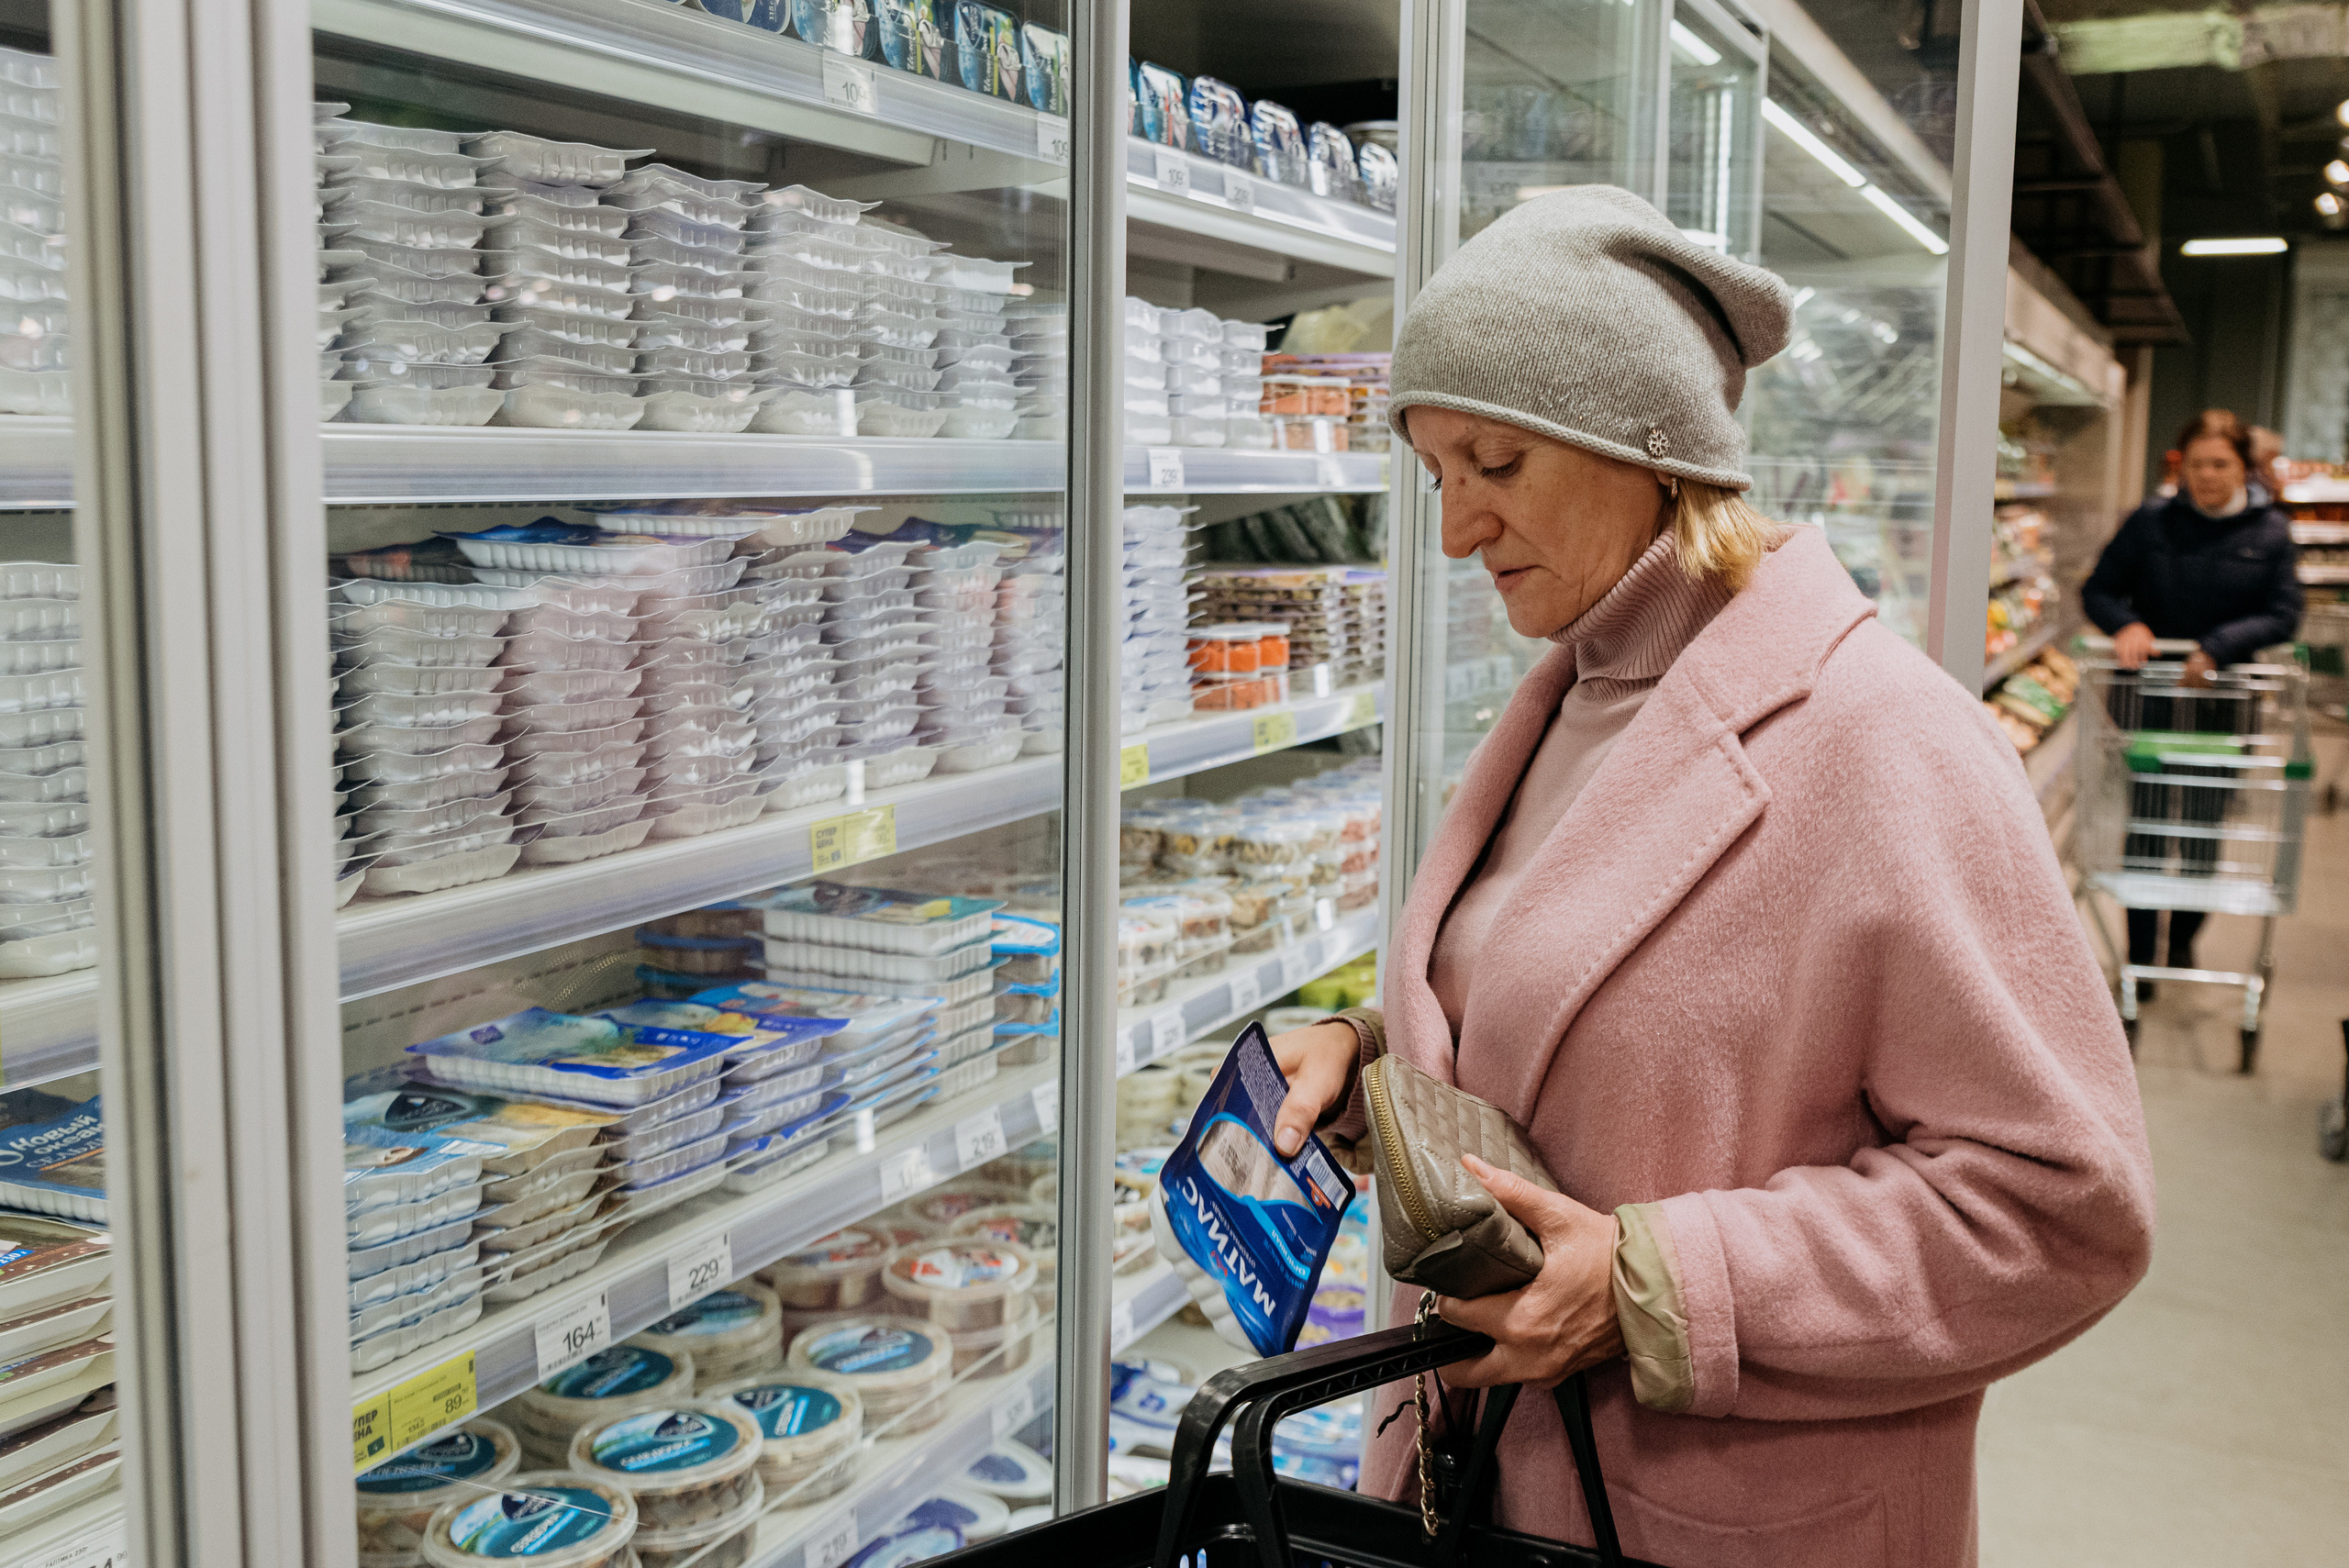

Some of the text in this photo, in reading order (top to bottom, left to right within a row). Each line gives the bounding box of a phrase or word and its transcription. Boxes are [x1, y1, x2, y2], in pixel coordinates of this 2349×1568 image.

[9, 1114, 98, 1151] Новый
[1182, 1175, 1277, 1318] МАТИАС
[1271, 1229, 1306, 1276] ОРИГИНАЛ
[689, 1258, 719, 1290] 229
[562, 1319, 596, 1353] 164
[445, 1394, 462, 1414] 89
